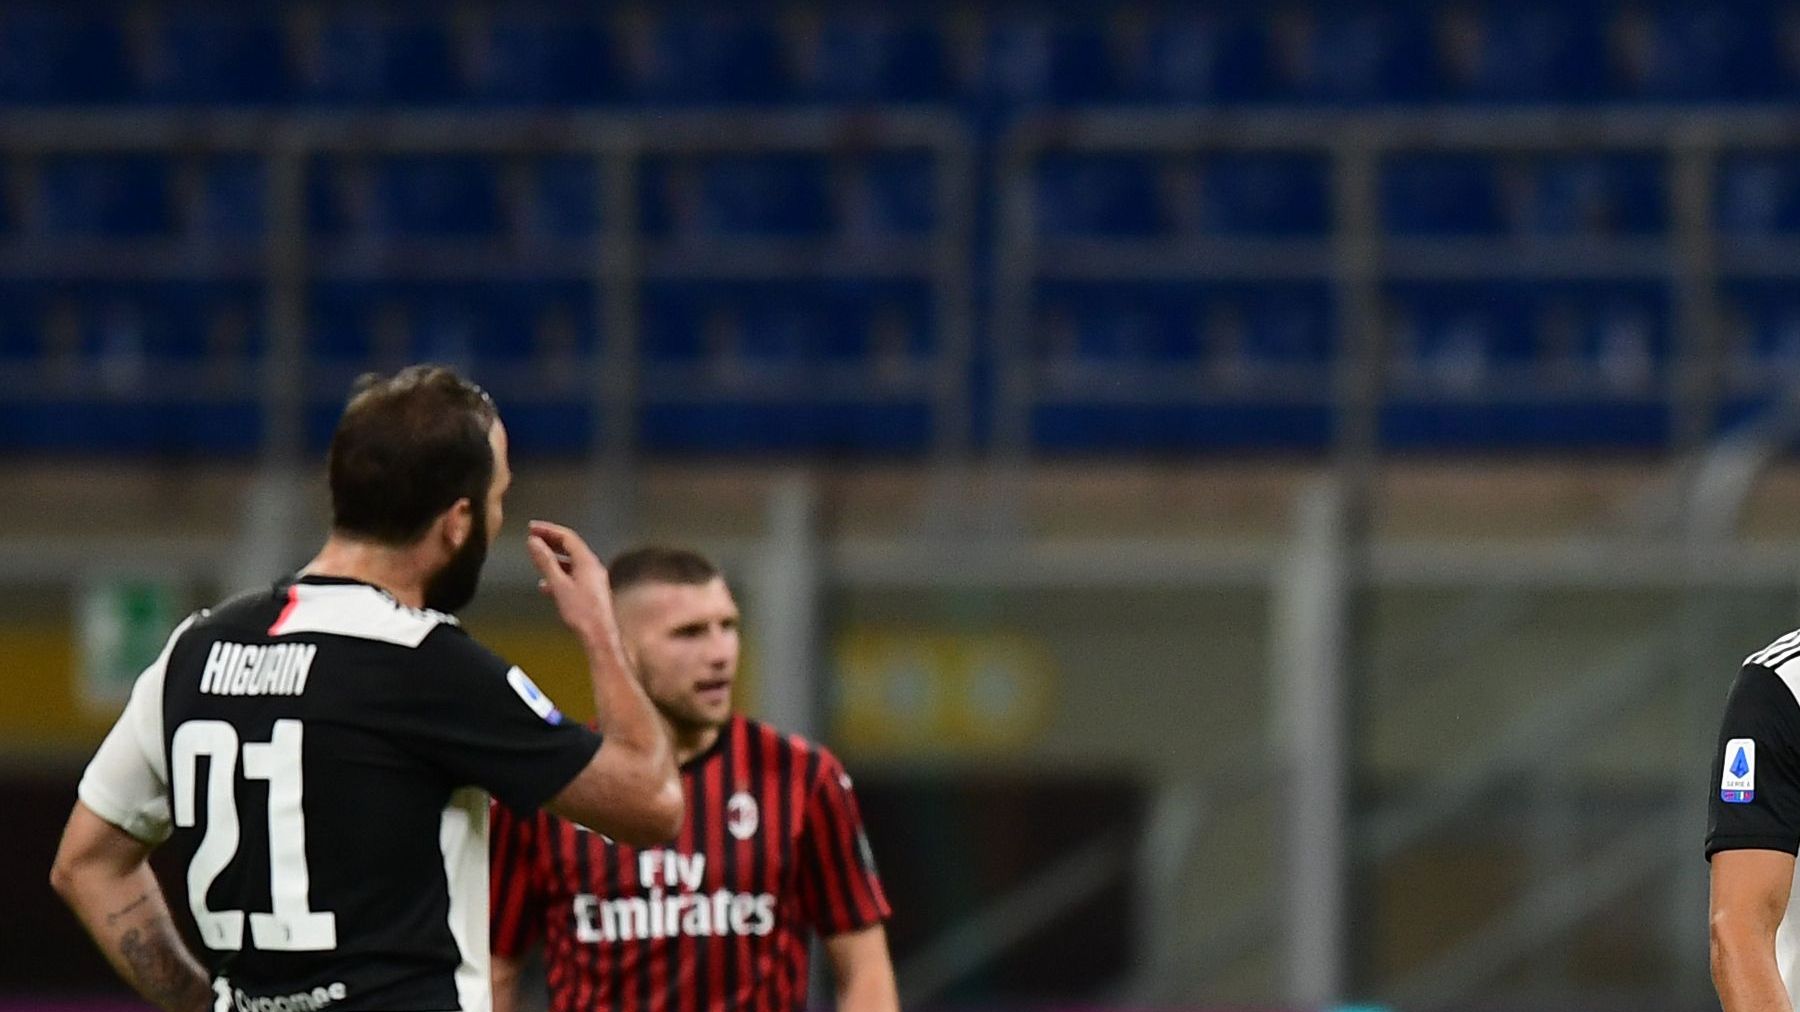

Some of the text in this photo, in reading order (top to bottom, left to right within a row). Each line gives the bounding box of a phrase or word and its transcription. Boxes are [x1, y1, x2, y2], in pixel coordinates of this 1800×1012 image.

[200, 640, 317, 696] HIGUAIN
[172, 718, 337, 951] 21
[639, 849, 706, 893] Fly
[573, 888, 776, 943] Emirates
